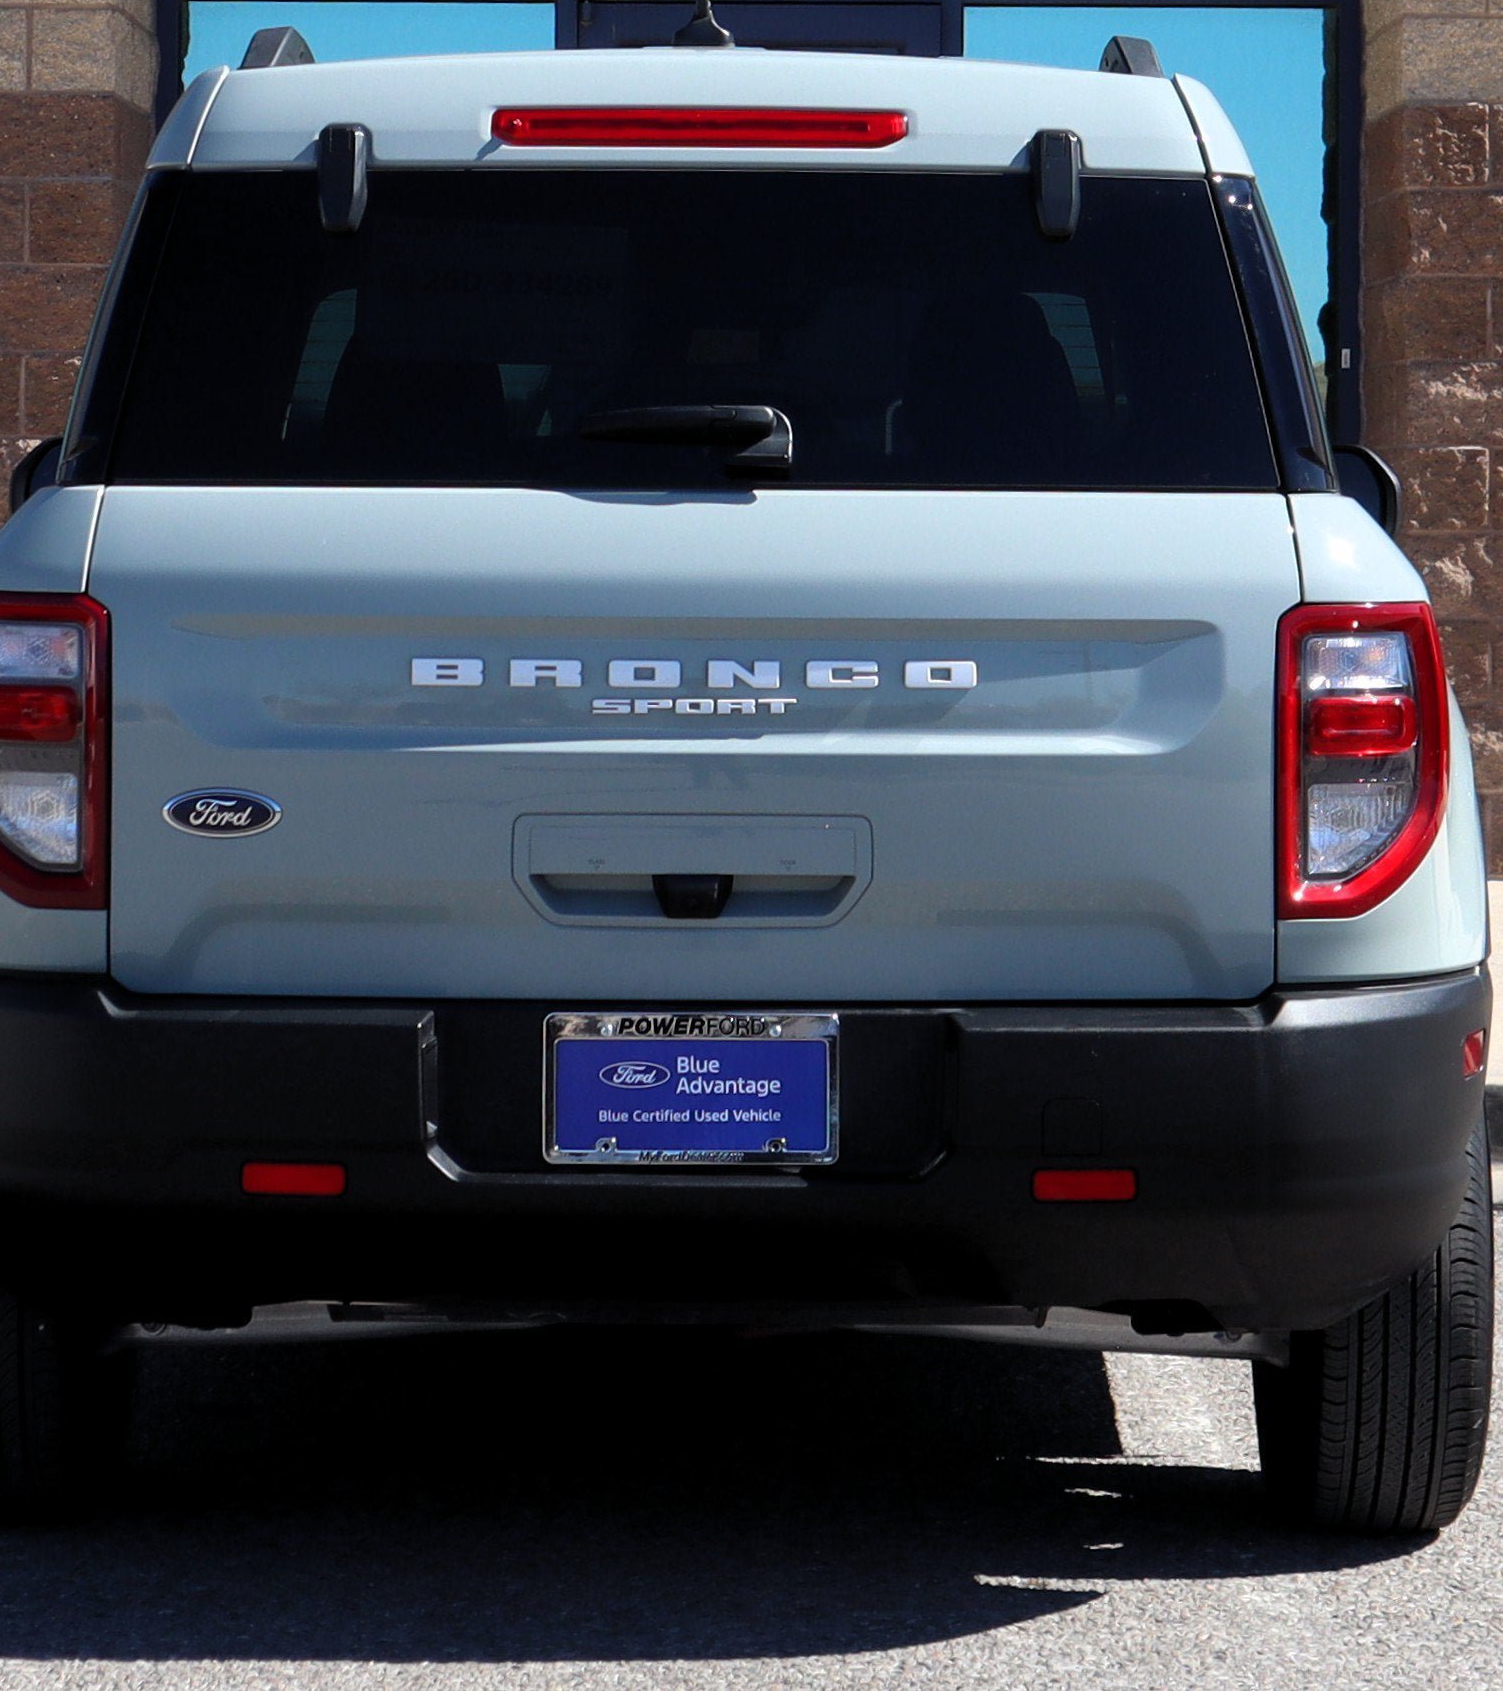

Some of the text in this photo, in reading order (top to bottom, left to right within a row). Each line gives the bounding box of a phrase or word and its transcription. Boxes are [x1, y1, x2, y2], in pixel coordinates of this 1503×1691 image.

[411, 657, 978, 688] BRONCO
[592, 698, 797, 714] SPORT
[189, 798, 252, 826] Ford
[676, 1056, 720, 1073] Blue
[612, 1065, 657, 1084] Ford
[676, 1076, 781, 1096] Advantage
[599, 1109, 781, 1122] Blue Certified Used Vehicle
